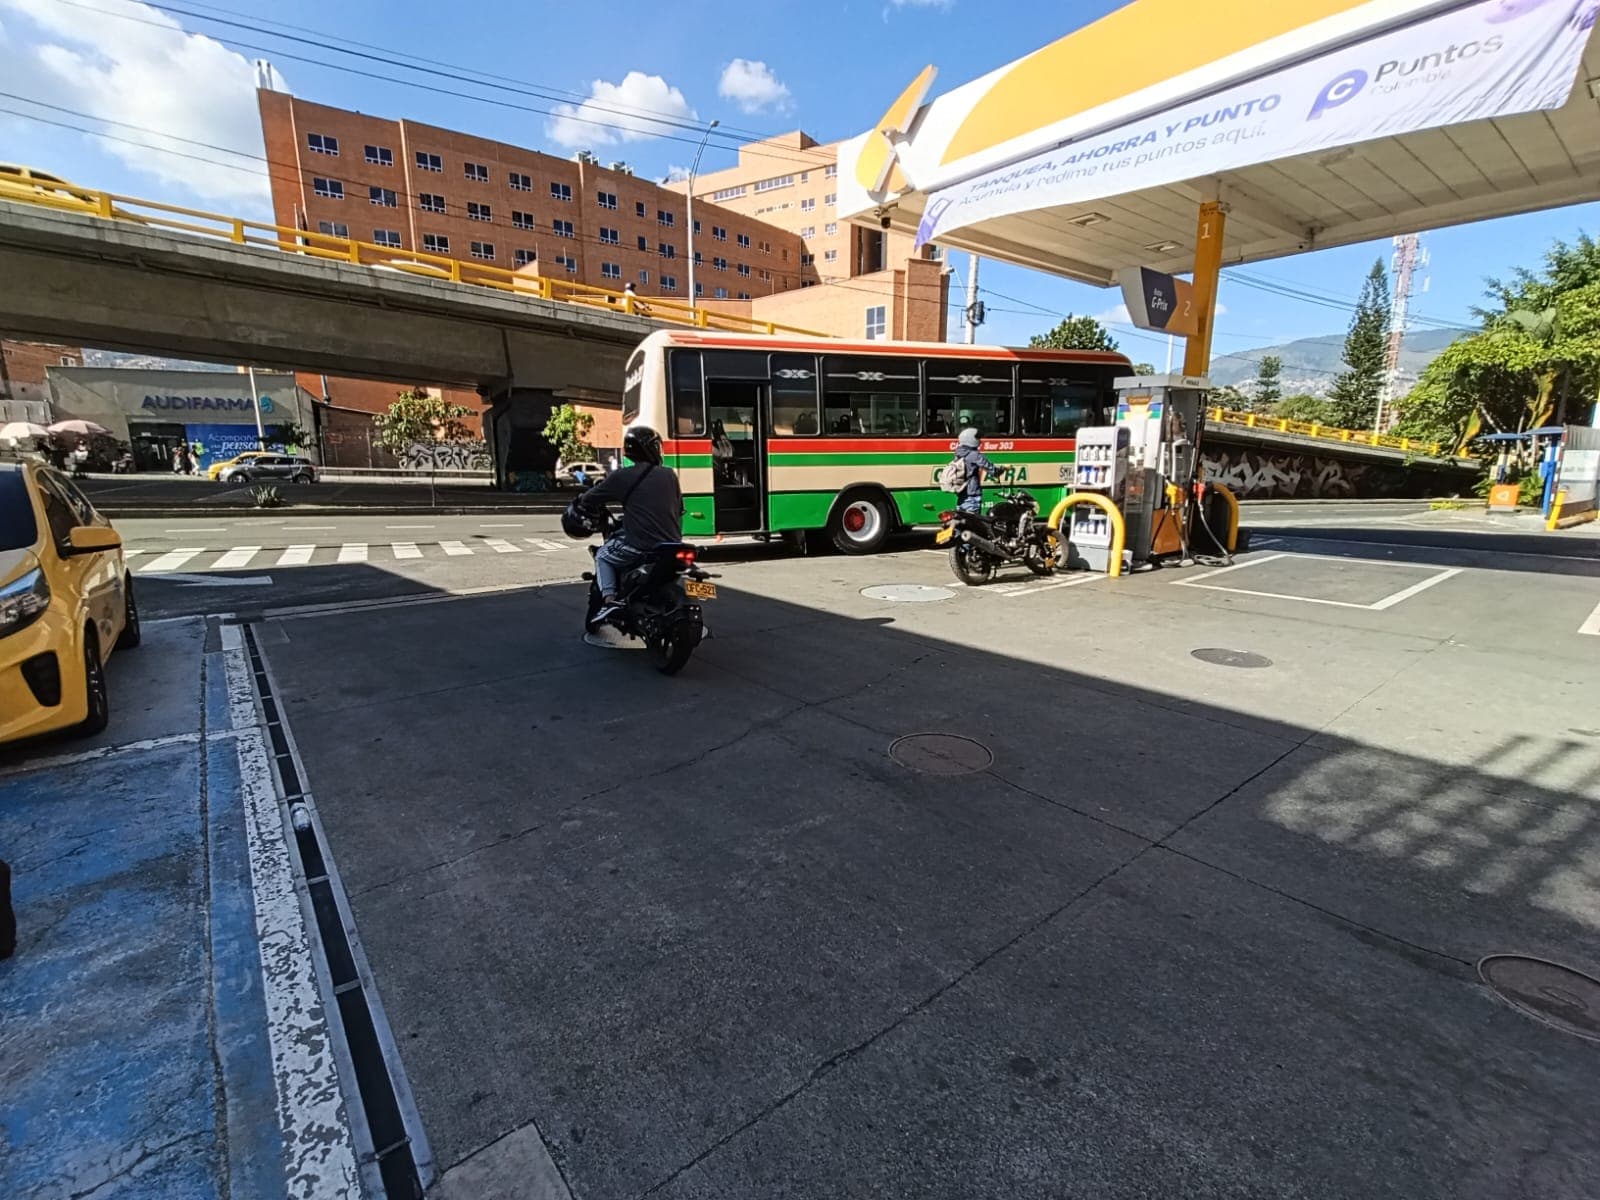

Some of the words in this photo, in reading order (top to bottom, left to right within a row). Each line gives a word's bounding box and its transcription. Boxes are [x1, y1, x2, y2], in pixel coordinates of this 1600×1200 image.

[1374, 35, 1505, 82] Puntos
[970, 161, 1058, 192] TANQUEA,
[1062, 130, 1157, 166] AHORRA
[1165, 121, 1181, 138] Y
[1183, 94, 1282, 133] PUNTO
[960, 180, 1020, 205] Acumula
[1036, 166, 1098, 187] redime
[1102, 157, 1132, 173] tus
[1134, 137, 1208, 168] puntos
[1201, 222, 1211, 239] 1
[1183, 300, 1192, 317] 2
[141, 395, 256, 411] AUDIFARMA
